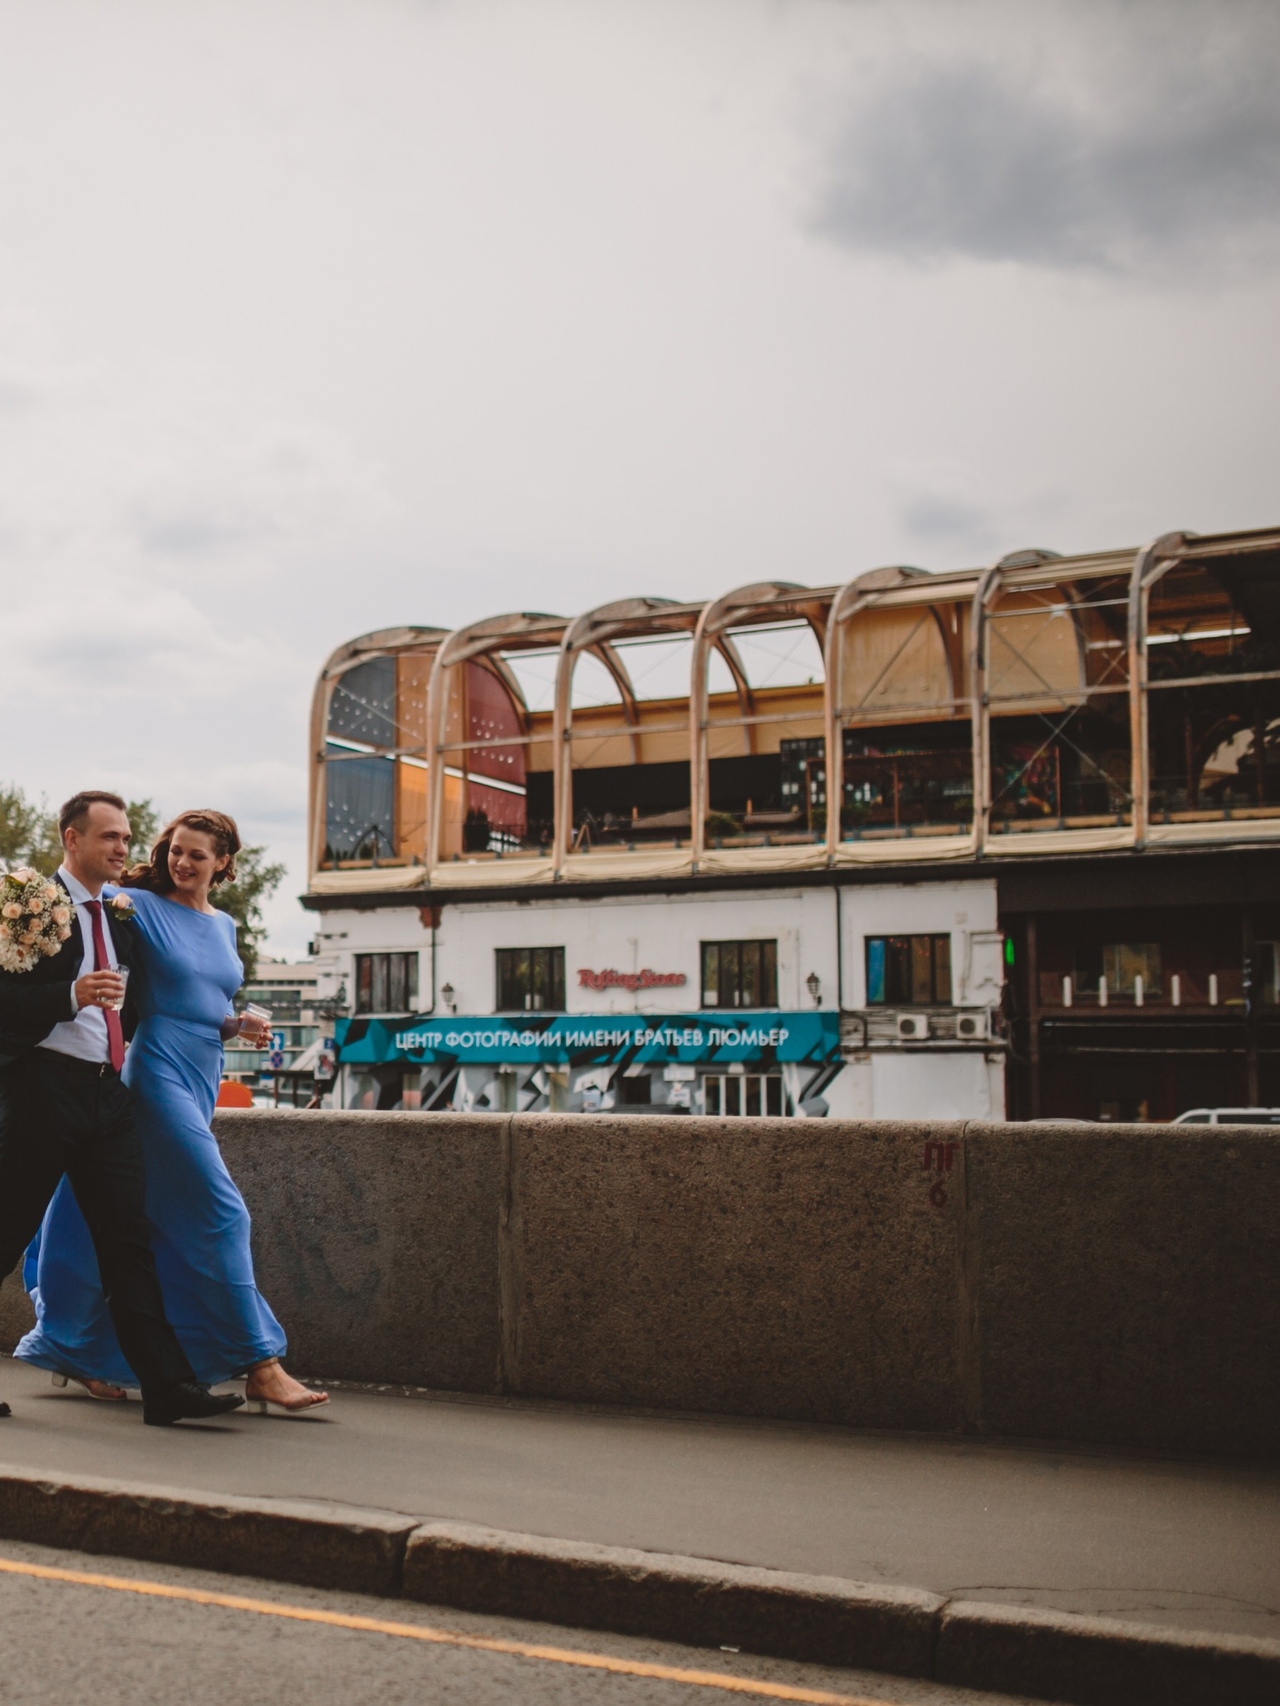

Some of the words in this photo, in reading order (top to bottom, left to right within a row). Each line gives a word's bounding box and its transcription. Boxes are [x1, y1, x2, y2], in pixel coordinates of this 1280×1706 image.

[395, 1032, 443, 1051] ЦЕНТР
[445, 1030, 562, 1048] ФОТОГРАФИИ
[566, 1029, 630, 1047] ИМЕНИ
[634, 1028, 704, 1046] БРАТЬЕВ
[707, 1028, 790, 1047] ЛЮМЬЕР
